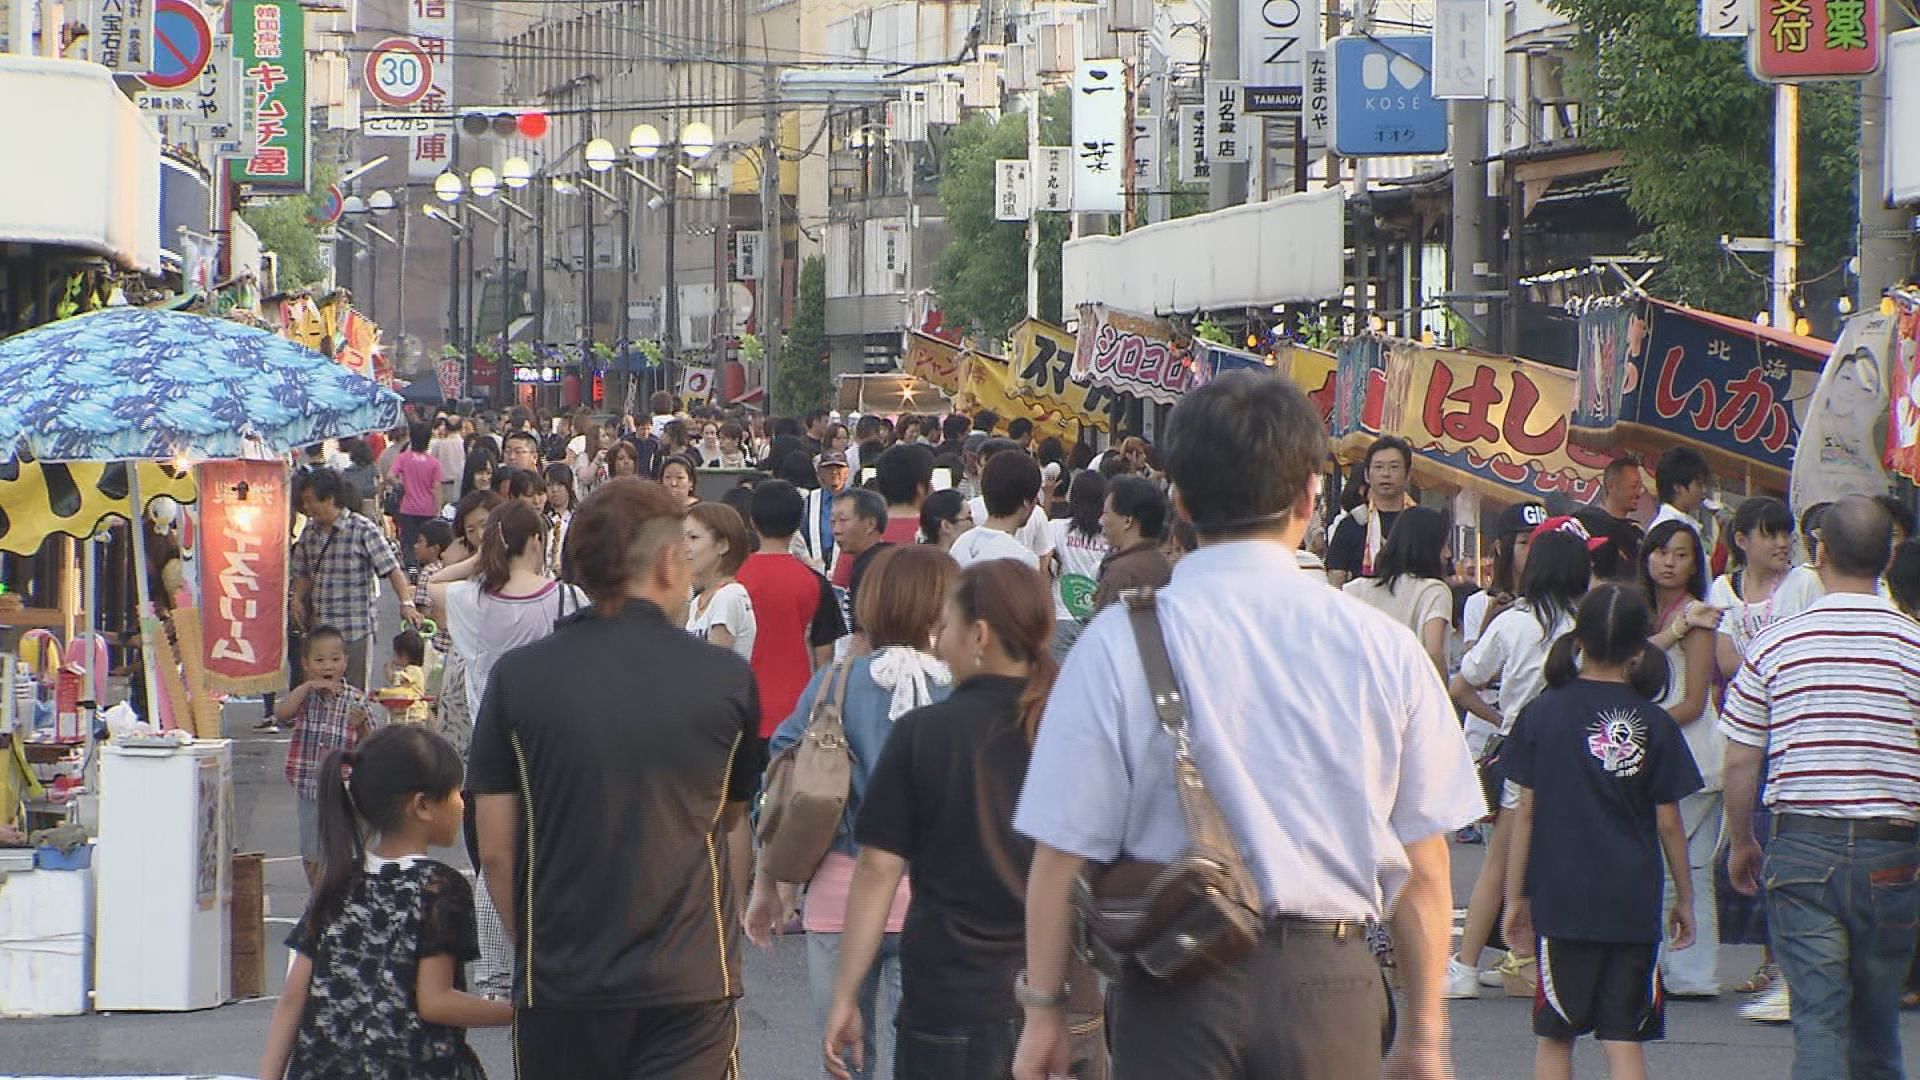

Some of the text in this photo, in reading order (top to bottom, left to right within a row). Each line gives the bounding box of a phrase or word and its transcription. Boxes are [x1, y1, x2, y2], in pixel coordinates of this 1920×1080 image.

[381, 58, 417, 86] 30
[1311, 58, 1328, 130] たまのや
[245, 61, 288, 176] キムチ屋
[1079, 68, 1117, 174] 二葉
[1218, 86, 1236, 157] 山名書店
[1655, 345, 1789, 453] いか
